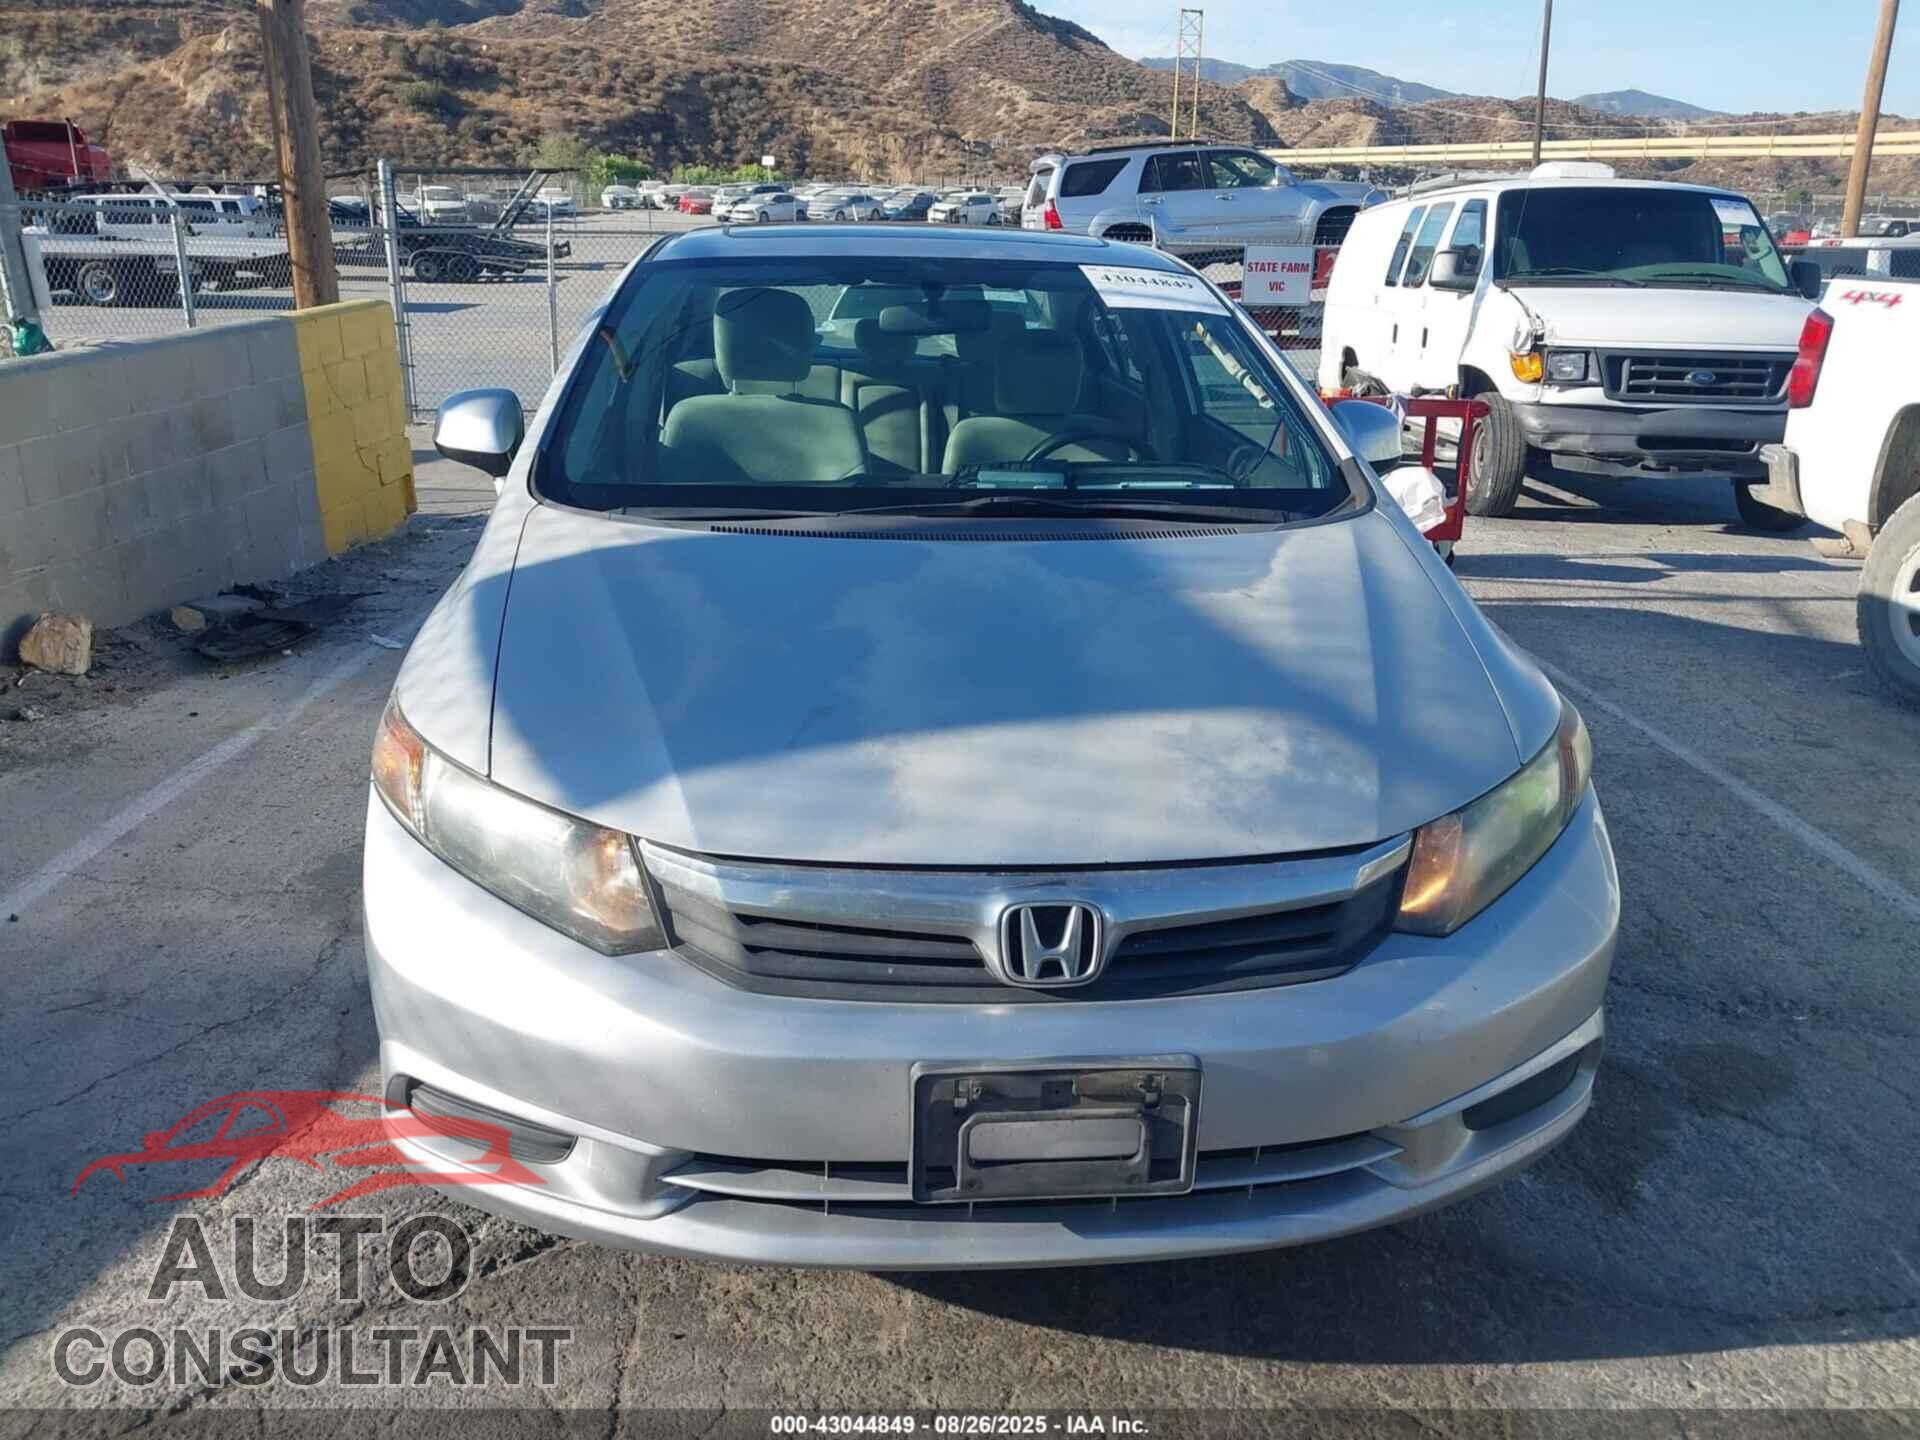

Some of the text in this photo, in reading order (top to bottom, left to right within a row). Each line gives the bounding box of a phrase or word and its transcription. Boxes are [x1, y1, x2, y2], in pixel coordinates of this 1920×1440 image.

[1247, 262, 1310, 273] STATE FARM
[1268, 281, 1286, 292] VIC
